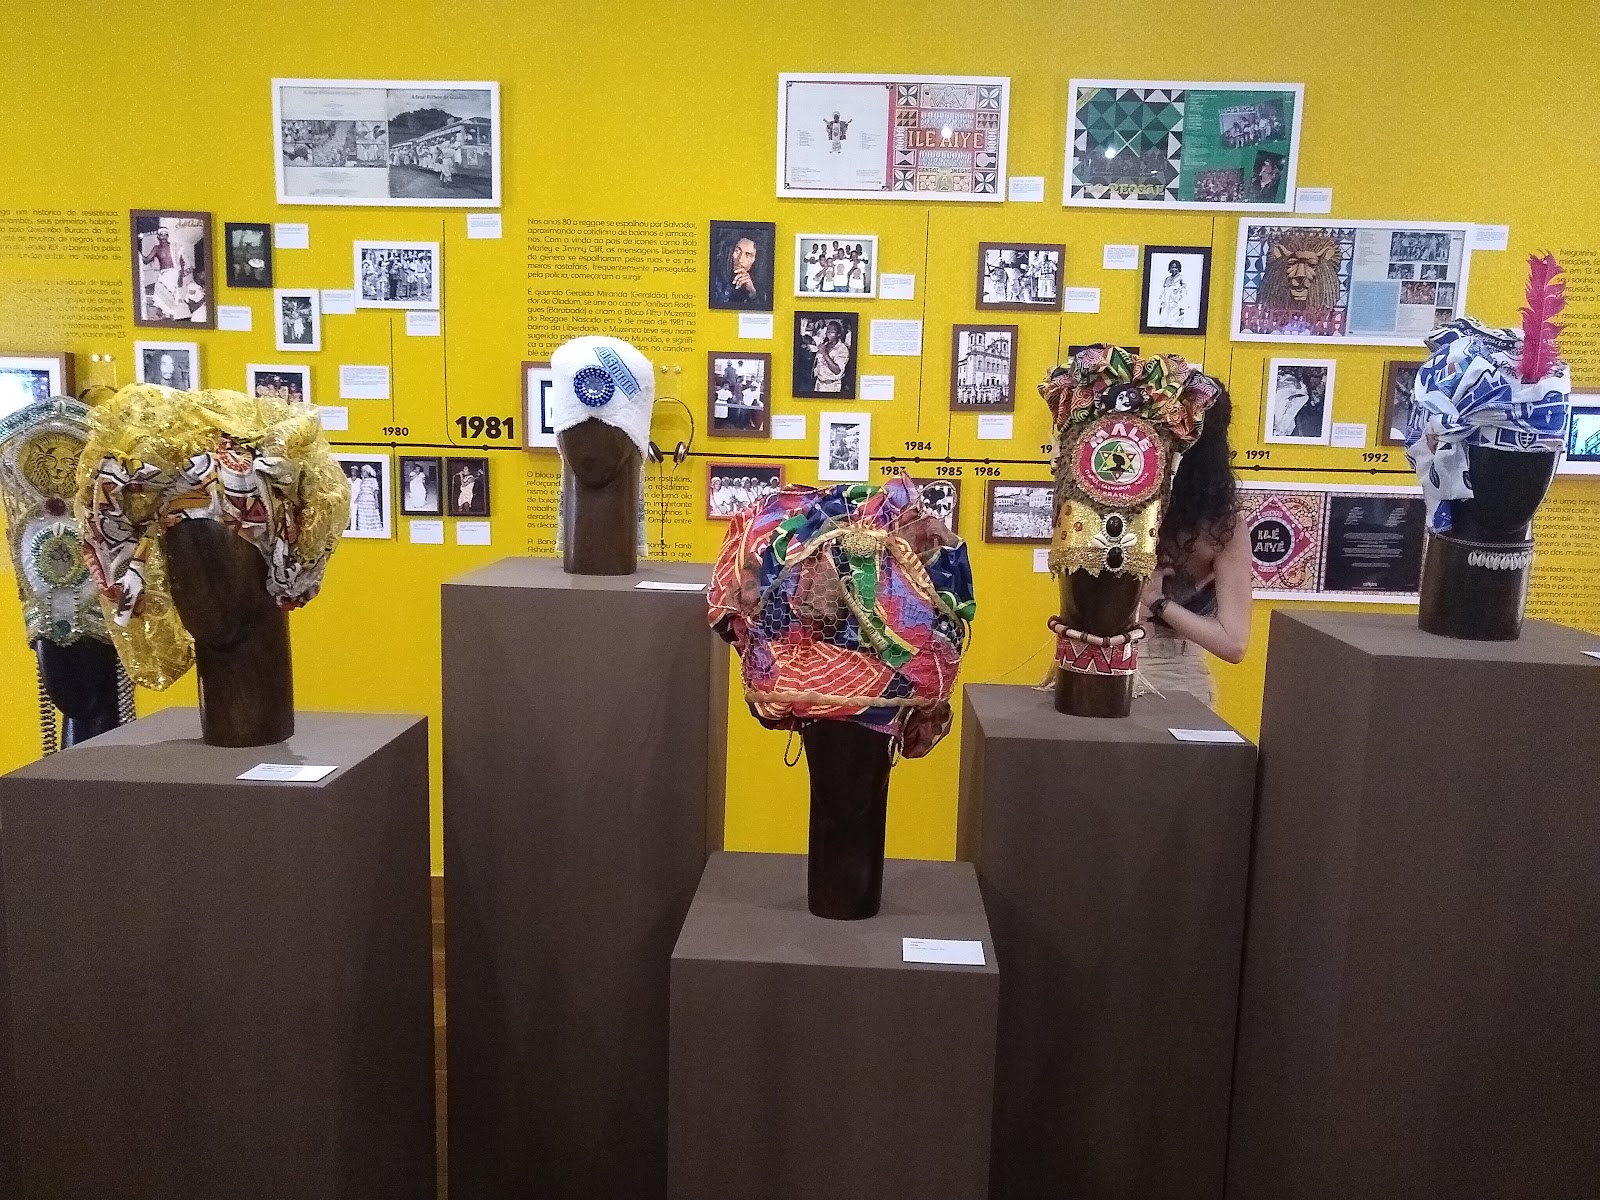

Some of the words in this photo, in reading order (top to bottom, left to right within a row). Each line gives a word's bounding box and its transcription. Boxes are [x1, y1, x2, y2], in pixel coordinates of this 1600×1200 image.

[382, 427, 409, 436] 1980
[455, 416, 514, 440] 1981
[905, 442, 931, 451] 1984
[1245, 450, 1270, 460] 1991
[1362, 453, 1388, 463] 1992
[936, 466, 962, 476] 1985
[974, 467, 1000, 477] 1986
